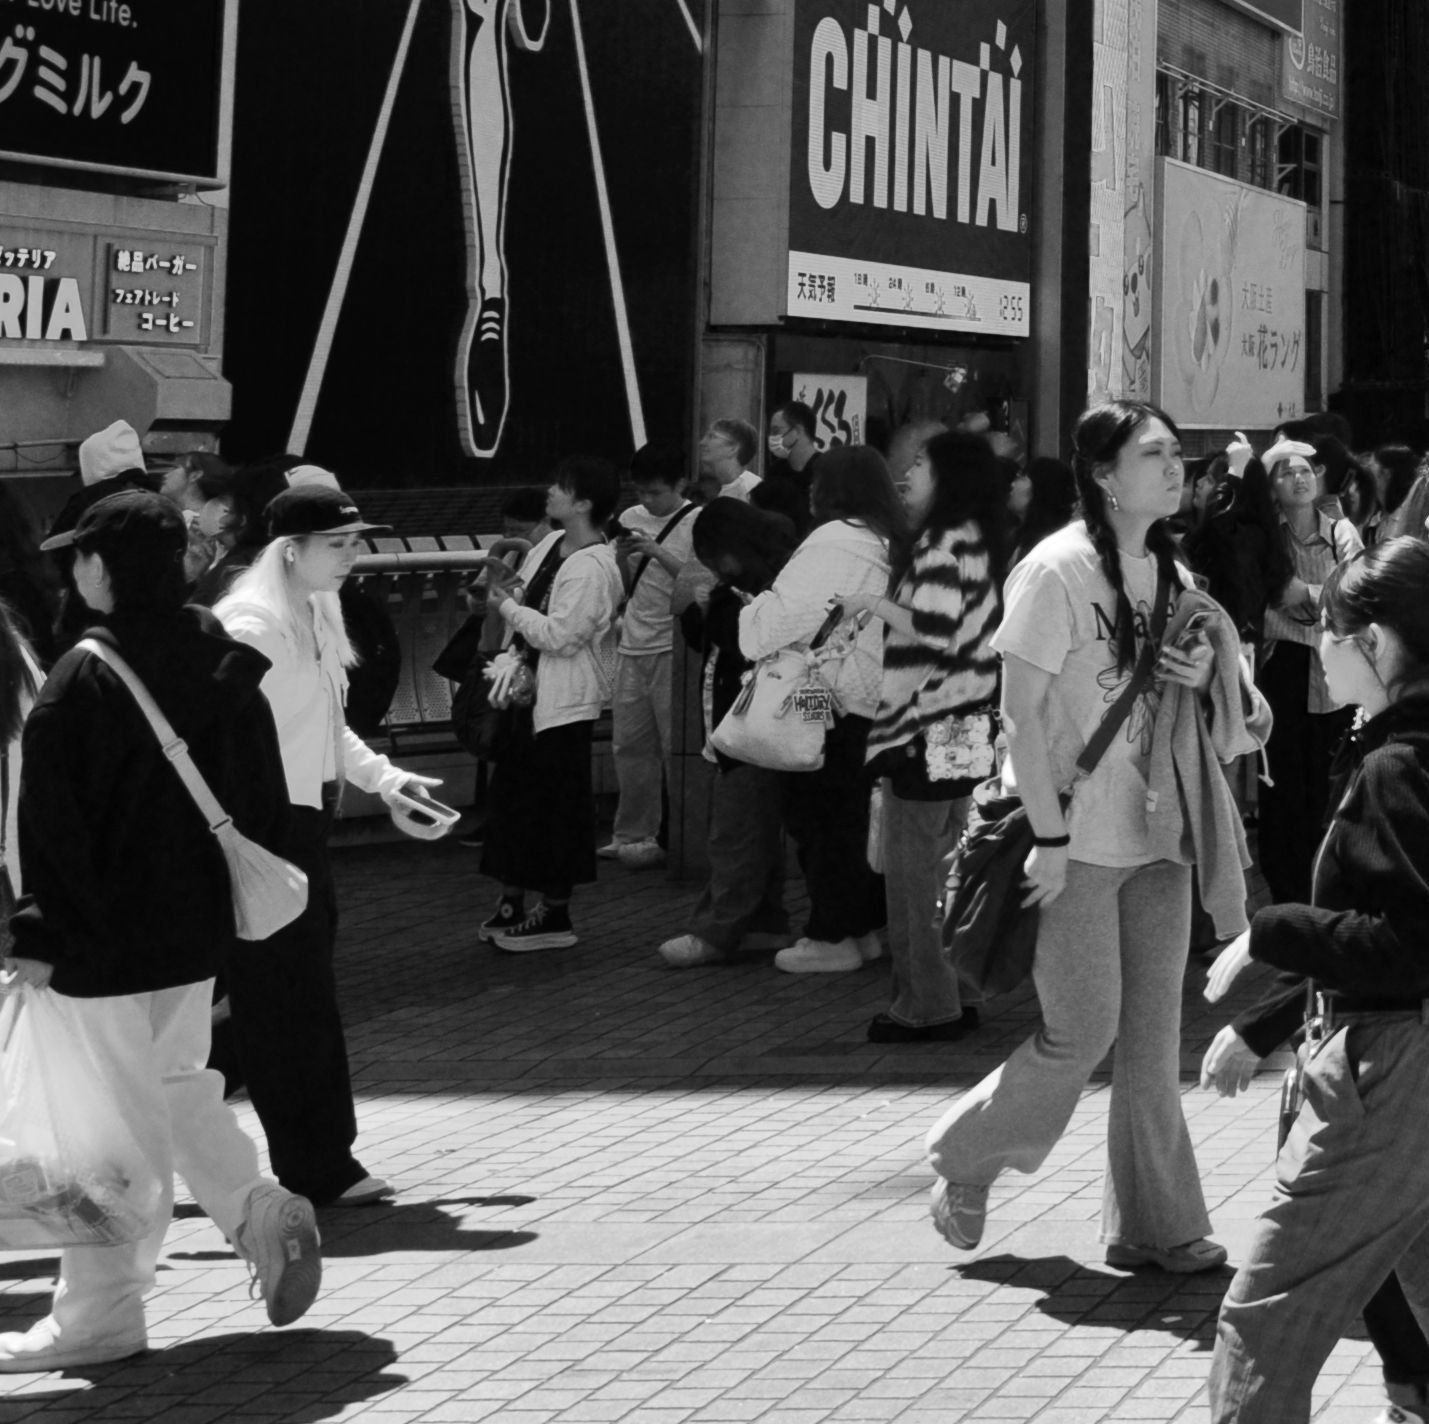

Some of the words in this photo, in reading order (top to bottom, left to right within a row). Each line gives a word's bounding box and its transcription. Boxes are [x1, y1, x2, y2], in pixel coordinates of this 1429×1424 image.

[808, 13, 1022, 233] CHINTAI
[116, 250, 197, 275] 絶品バーガー
[115, 289, 181, 307] フェアトレード
[798, 272, 836, 304] 天気予報
[142, 313, 194, 333] コーヒー
